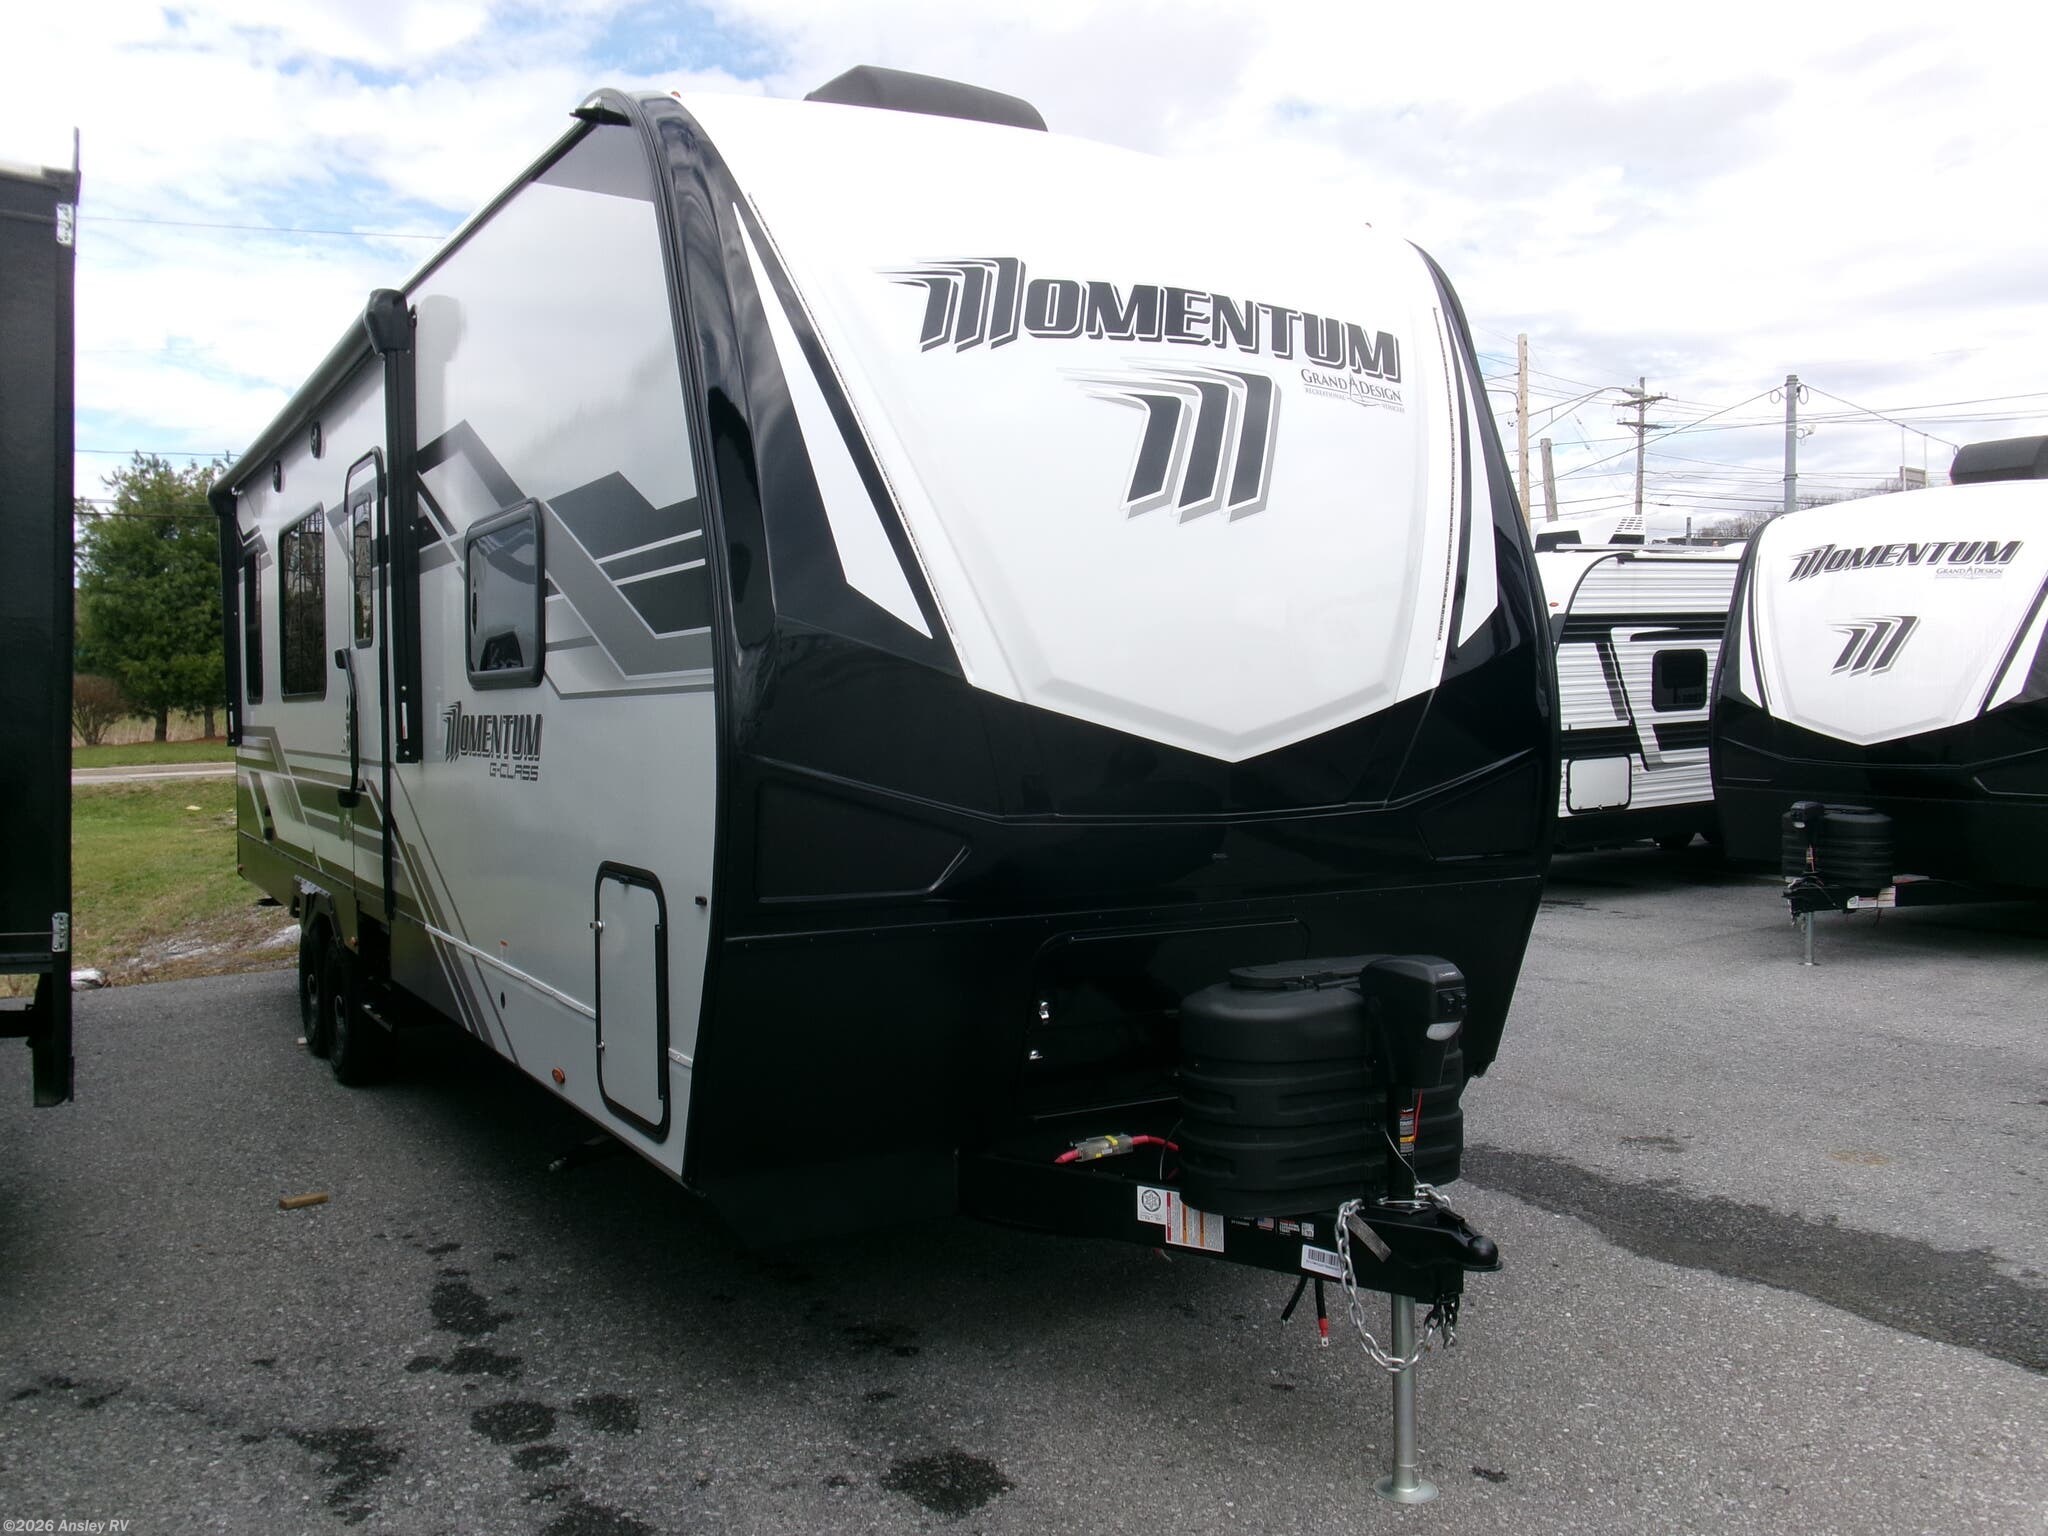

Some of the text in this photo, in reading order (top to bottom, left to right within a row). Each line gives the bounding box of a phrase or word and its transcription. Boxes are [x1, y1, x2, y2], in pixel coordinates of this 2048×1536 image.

[873, 256, 1402, 384] MOMENTUM
[1301, 368, 1403, 403] GRAND DESIGN
[1788, 540, 2024, 583] MOMENTUM
[442, 700, 544, 763] MOMENTUM
[489, 762, 539, 781] G-CLASS
